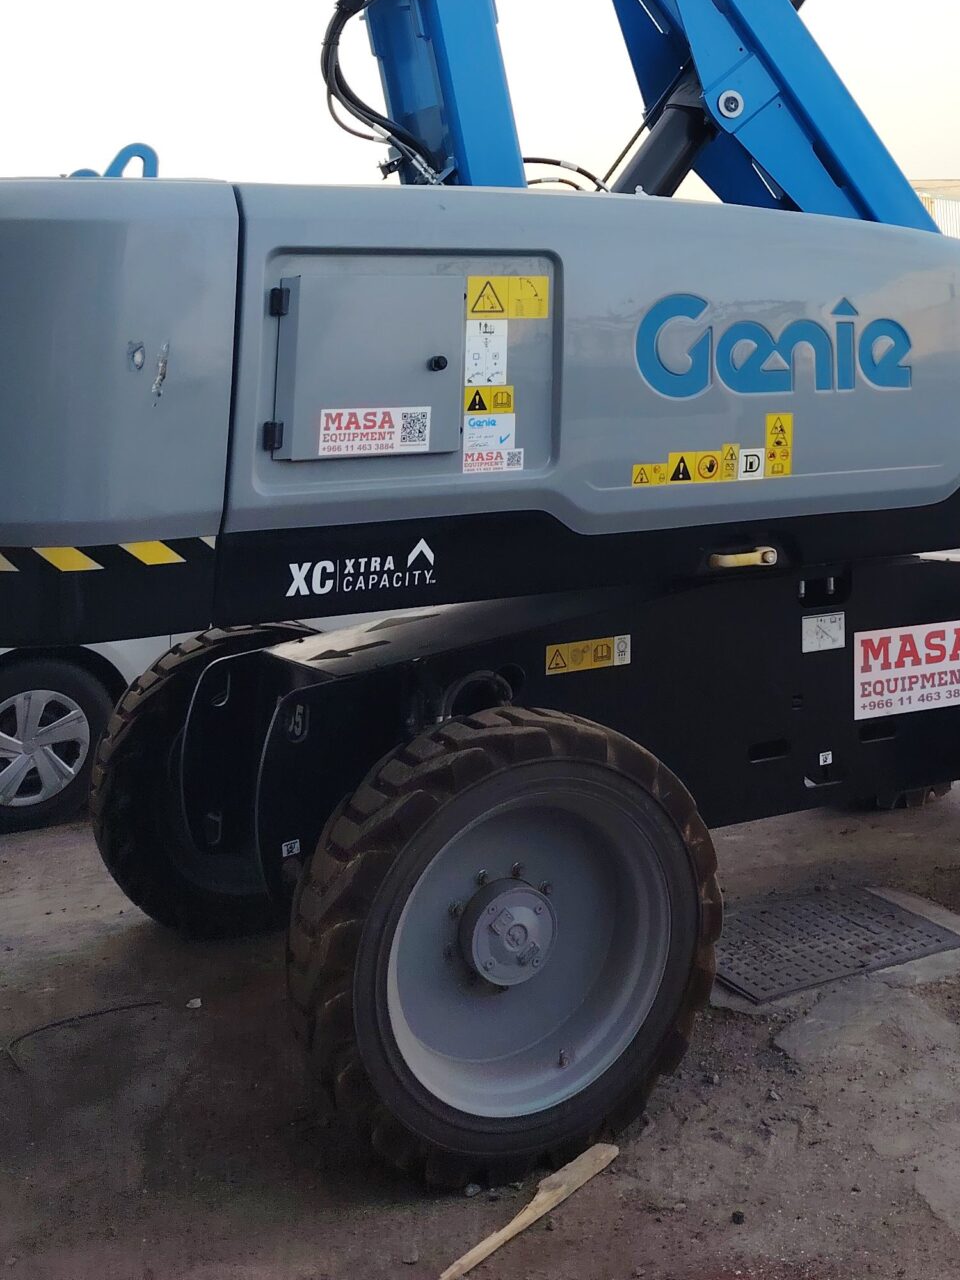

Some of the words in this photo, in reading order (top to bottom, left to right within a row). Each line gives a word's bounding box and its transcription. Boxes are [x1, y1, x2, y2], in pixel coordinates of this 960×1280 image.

[635, 293, 912, 401] Genie
[323, 410, 395, 431] MASA
[468, 417, 497, 427] Genie
[322, 431, 395, 443] EQUIPMENT
[345, 444, 354, 452] 11
[357, 443, 372, 451] 463
[464, 451, 504, 462] MASA
[343, 555, 395, 575] XTRA
[285, 560, 335, 597] XC
[861, 699, 893, 711] +966
[898, 696, 912, 706] 11
[917, 690, 941, 702] 463
